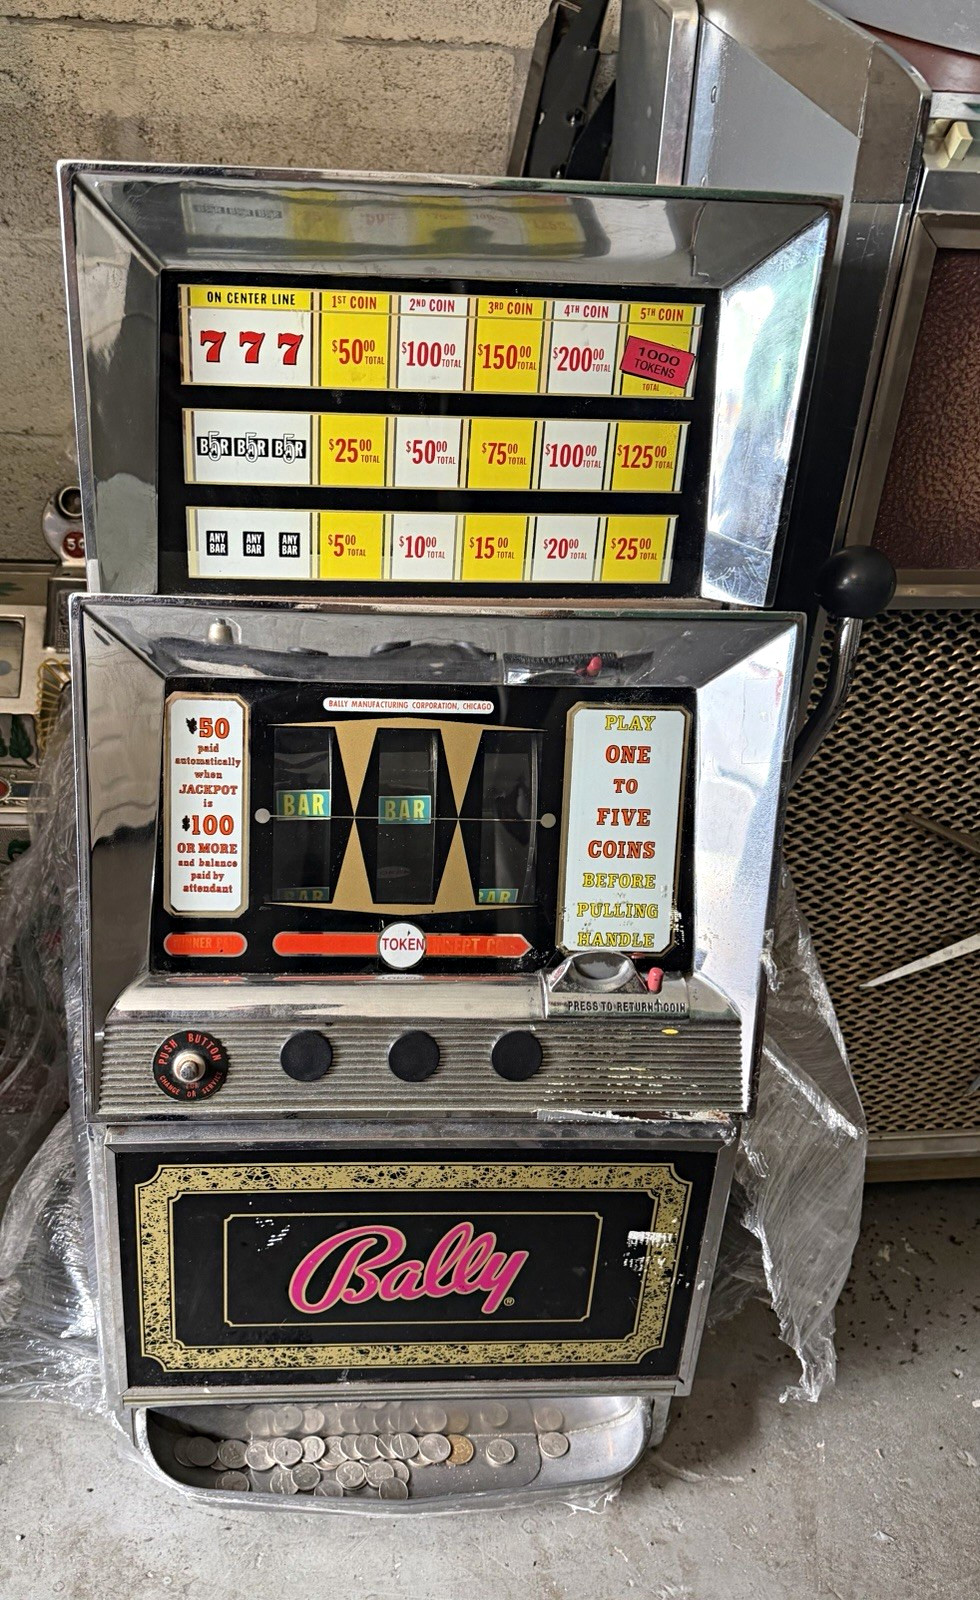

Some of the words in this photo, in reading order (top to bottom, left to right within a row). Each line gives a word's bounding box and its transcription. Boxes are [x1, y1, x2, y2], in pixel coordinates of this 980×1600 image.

[207, 291, 222, 303] ON
[227, 292, 267, 304] CENTER
[272, 293, 296, 306] LINE
[331, 295, 346, 308] 1ST
[350, 296, 377, 310] COIN
[409, 298, 426, 311] 2ND
[429, 299, 455, 312] COIN
[488, 301, 504, 314] 3RD
[507, 302, 533, 315] COIN
[564, 304, 580, 317] 4TH
[583, 305, 609, 318] COIN
[640, 307, 656, 320] 5TH
[658, 308, 684, 322] COIN
[200, 330, 226, 363] 7
[239, 330, 266, 363] 7
[277, 332, 304, 365] 7
[365, 355, 385, 365] TOTAL
[638, 347, 681, 367] 1000
[442, 359, 462, 368] TOTAL
[517, 361, 537, 371] TOTAL
[592, 363, 611, 373] TOTAL
[634, 358, 676, 379] TOKENS
[642, 383, 660, 392] TOTAL
[361, 455, 380, 464] TOTAL
[437, 456, 456, 465] TOTAL
[508, 456, 527, 465] TOTAL
[583, 459, 602, 469] TOTAL
[654, 460, 674, 470] TOTAL
[209, 532, 226, 543] ANY
[246, 533, 262, 544] ANY
[282, 535, 298, 545] ANY
[209, 543, 226, 554] BAR
[246, 544, 262, 554] BAR
[282, 545, 298, 555] BAR
[347, 548, 367, 557] TOTAL
[427, 550, 445, 559] TOTAL
[497, 551, 515, 560] TOTAL
[570, 552, 588, 560] TOTAL
[639, 552, 658, 561] TOTAL
[328, 700, 348, 708] BALLY
[351, 700, 408, 709] MANUFACTURING
[412, 701, 459, 710] CORPORATION,
[462, 702, 492, 711] CHICAGO
[604, 715, 656, 731] PLAY
[198, 743, 219, 755] paid
[605, 745, 651, 764] ONE
[175, 757, 241, 768] automatically
[194, 769, 223, 779] when
[179, 784, 238, 795] JACKPOT
[613, 778, 638, 794] TO
[203, 799, 213, 807] is
[283, 793, 325, 817] BAR
[384, 799, 425, 822] BAR
[596, 808, 651, 826] FIVE
[182, 815, 234, 835] $100
[177, 843, 196, 853] OR
[198, 843, 238, 854] MORE
[588, 840, 656, 859] COINS
[178, 858, 195, 867] and
[199, 858, 238, 867] balance
[191, 871, 211, 881] paid
[213, 871, 225, 882] by
[582, 873, 656, 889] BEFORE
[183, 883, 233, 893] attendant
[576, 903, 659, 918] PULLING
[382, 938, 424, 951] TOKEN
[577, 932, 655, 948] HANDLE
[568, 1001, 599, 1012] PRESS
[601, 1001, 613, 1012] TO
[617, 1002, 653, 1012] RETURN
[662, 1003, 686, 1013] COIN
[158, 1039, 178, 1065] PUSH
[187, 1033, 222, 1061] BUTTON
[160, 1075, 180, 1095] CHANGE
[288, 1221, 529, 1314] Bally
